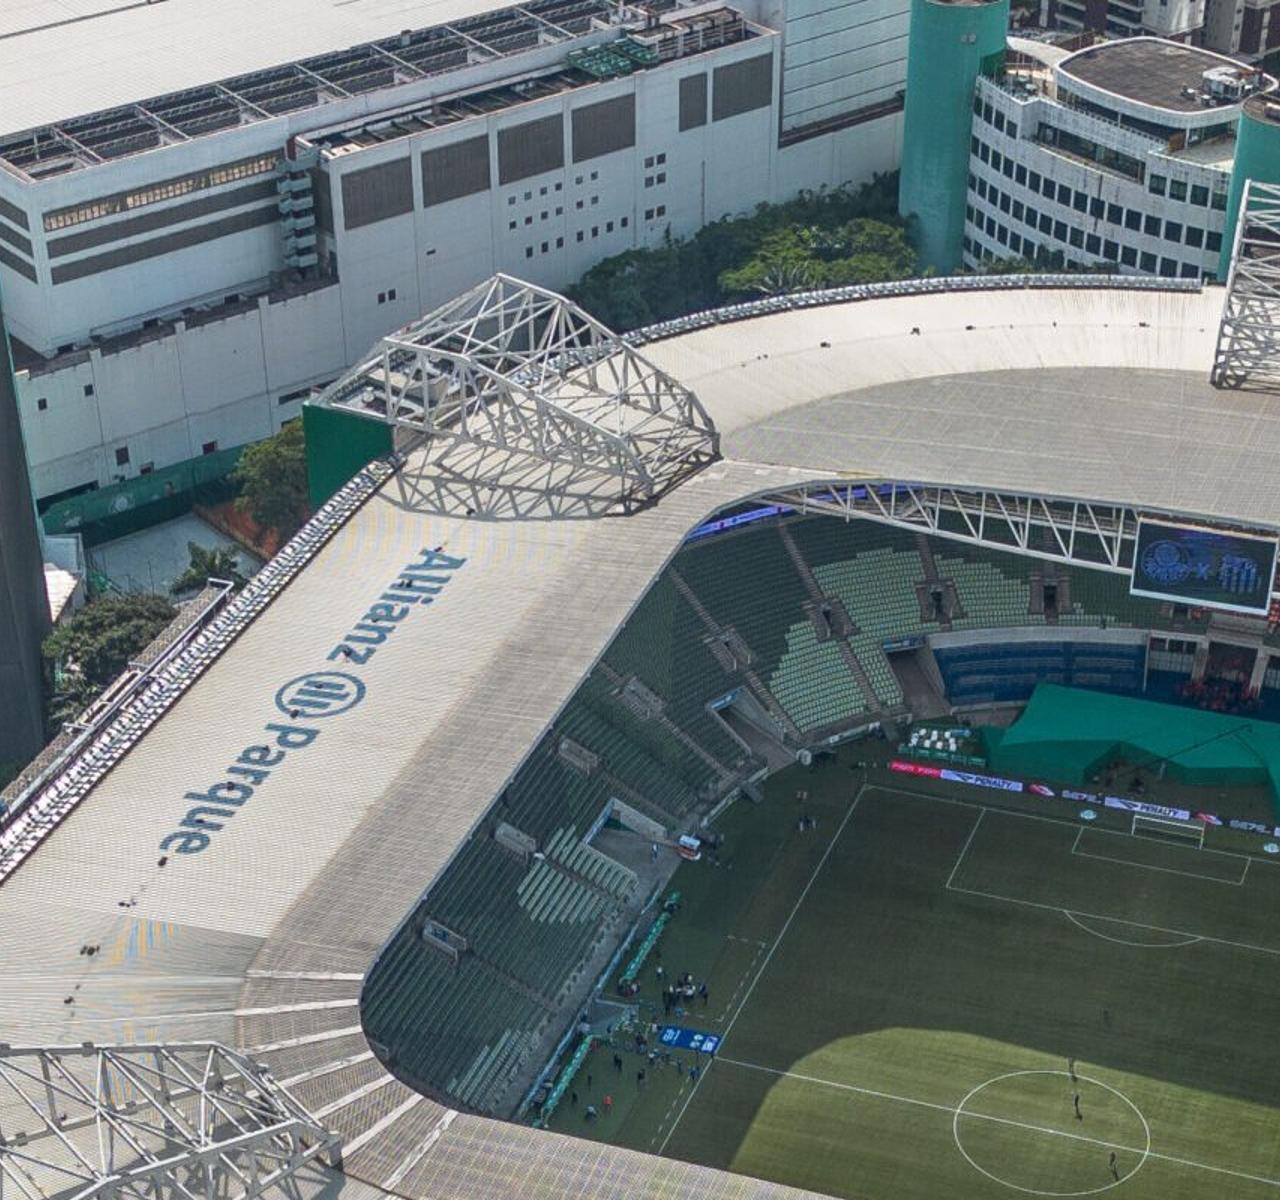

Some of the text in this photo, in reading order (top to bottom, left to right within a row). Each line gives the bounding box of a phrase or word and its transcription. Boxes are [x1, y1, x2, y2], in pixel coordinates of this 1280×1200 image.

[159, 546, 468, 856] Allianz Parque
[975, 776, 1013, 790] PENALTY
[1139, 803, 1180, 818] PENALTY
